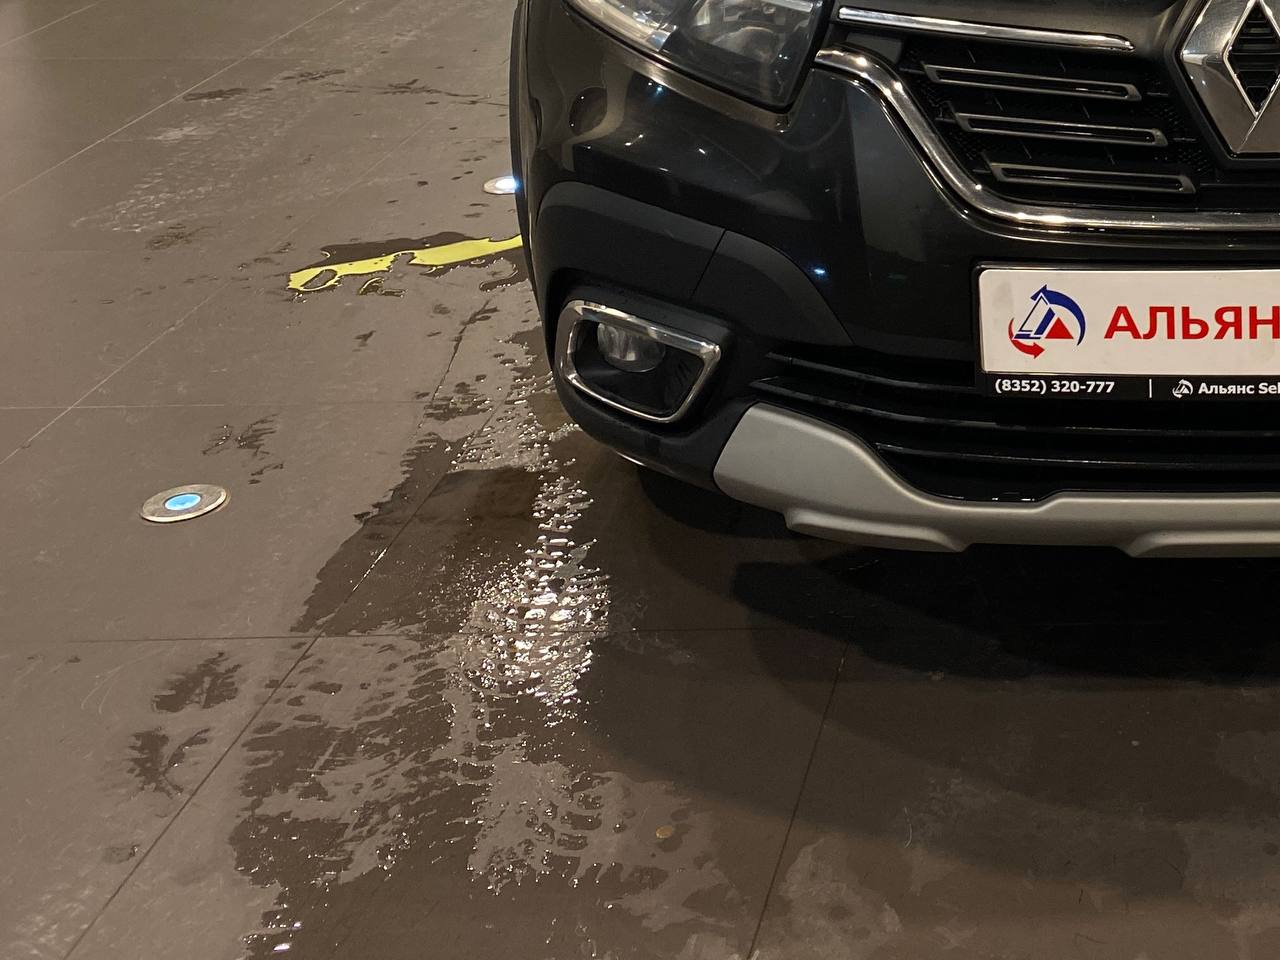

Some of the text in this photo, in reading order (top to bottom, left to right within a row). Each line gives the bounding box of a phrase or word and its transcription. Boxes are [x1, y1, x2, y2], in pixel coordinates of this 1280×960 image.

[995, 378, 1115, 395] (8352) 320-777
[1198, 382, 1255, 394] Альянс
